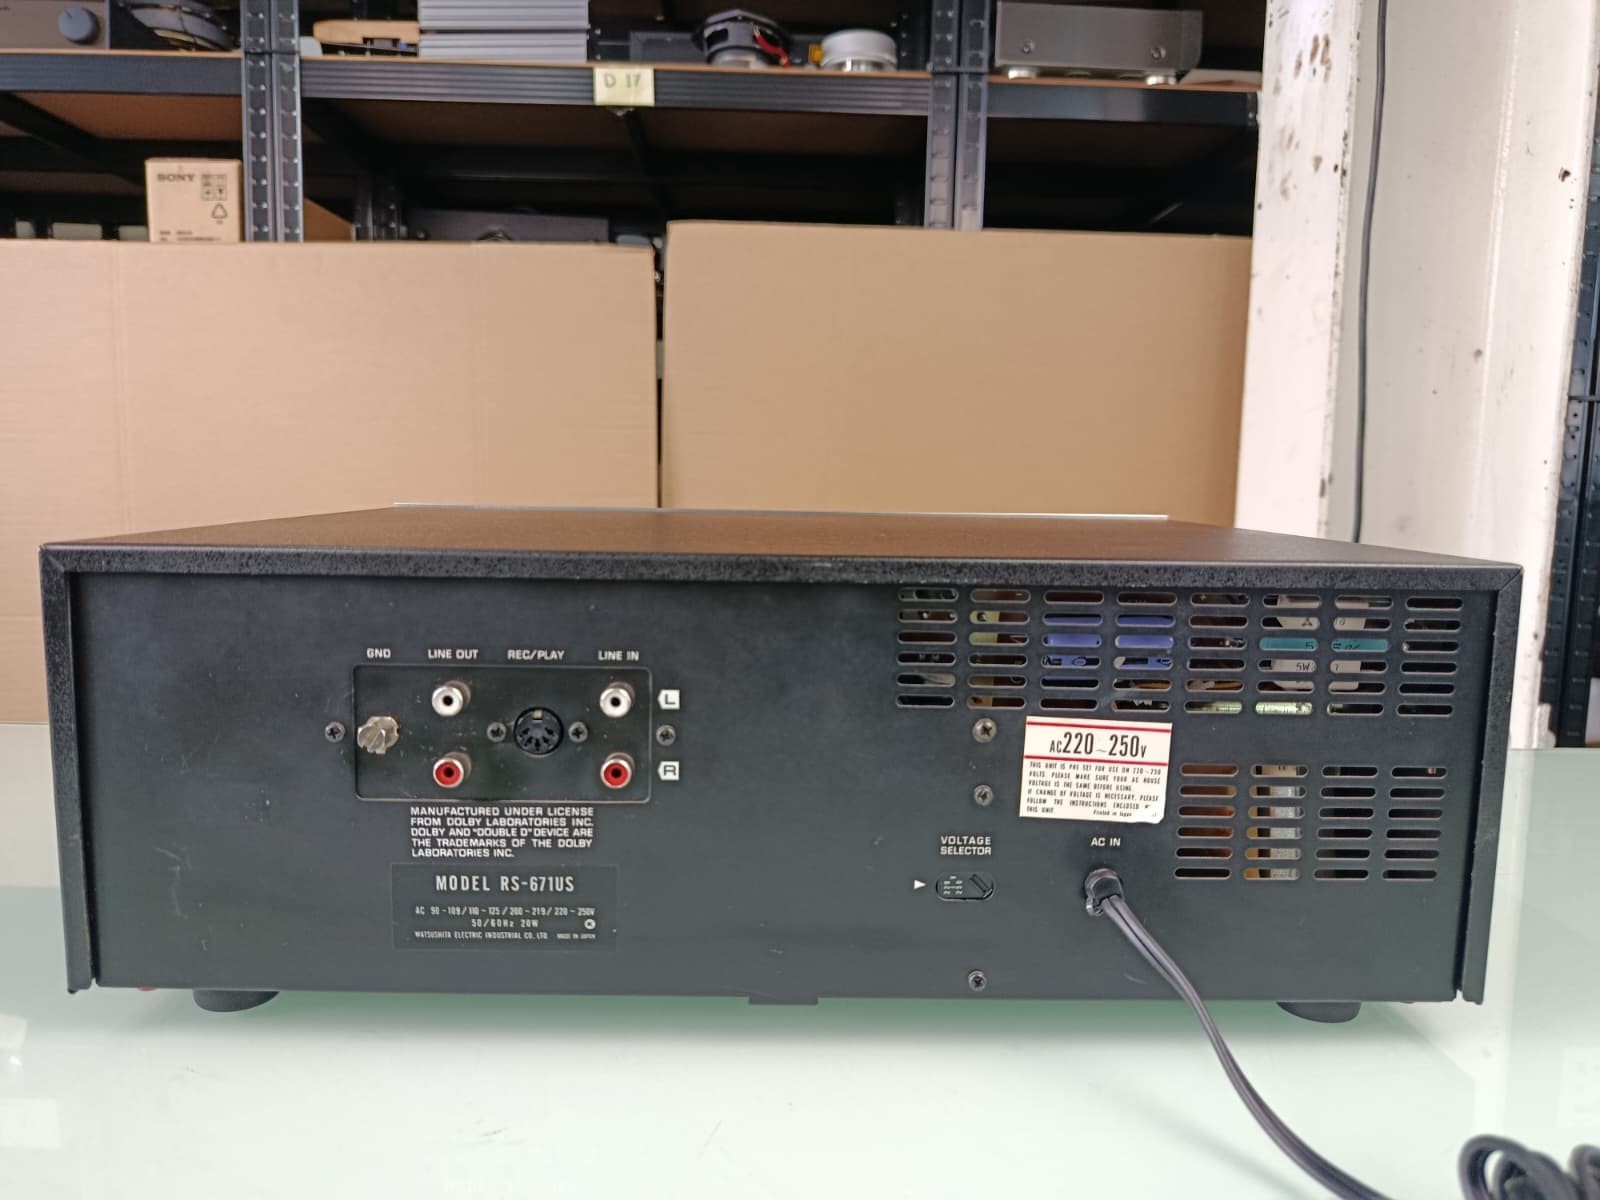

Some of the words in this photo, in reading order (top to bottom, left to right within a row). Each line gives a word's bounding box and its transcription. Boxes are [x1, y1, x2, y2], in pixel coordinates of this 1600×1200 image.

[603, 73, 617, 89] D
[157, 173, 195, 182] SONY
[366, 648, 391, 659] GND
[428, 649, 452, 659] LINE
[456, 649, 479, 660] OUT
[507, 650, 564, 661] REC/PLAY
[598, 651, 624, 661] LINE
[626, 651, 639, 662] IN
[1028, 779, 1051, 787] VOLTAGE
[1075, 782, 1091, 790] SAME
[1093, 783, 1112, 791] BEFORE
[1026, 805, 1038, 813] THIS
[1054, 798, 1063, 806] THE
[1069, 799, 1107, 808] INSTRUCTIONS
[1113, 801, 1140, 810] ENCLOSED
[410, 806, 500, 817] MANUFACTURED
[504, 806, 543, 817] UNDER
[547, 806, 594, 817] LICENSE
[410, 817, 442, 827] FROM
[446, 817, 482, 827] DOLBY
[485, 817, 567, 827] LABORATORIES
[571, 818, 594, 827] INC.
[410, 827, 445, 837] DOLBY
[449, 827, 471, 837] AND
[473, 828, 517, 837] "DOUBLE
[520, 828, 532, 837] D"
[533, 828, 569, 837] DEVICE
[572, 828, 593, 838] ARE
[411, 838, 431, 848] THE
[436, 838, 506, 848] TRADEMARKS
[511, 838, 526, 848] OF
[531, 838, 552, 848] THE
[557, 838, 592, 848] DOLBY
[940, 835, 992, 846] VOLTAGE
[1090, 837, 1106, 847] AC
[1109, 837, 1121, 847] IN
[411, 848, 490, 858] LABORATORIES
[493, 848, 515, 858] INC.
[940, 846, 992, 856] SELECTOR
[435, 875, 491, 892] MODEL
[415, 906, 425, 915] AC
[471, 918, 515, 928] 50/60Hz
[520, 919, 539, 928] 20W
[454, 931, 483, 939] ELECTRIC
[485, 931, 522, 940] INDUSTRIAL
